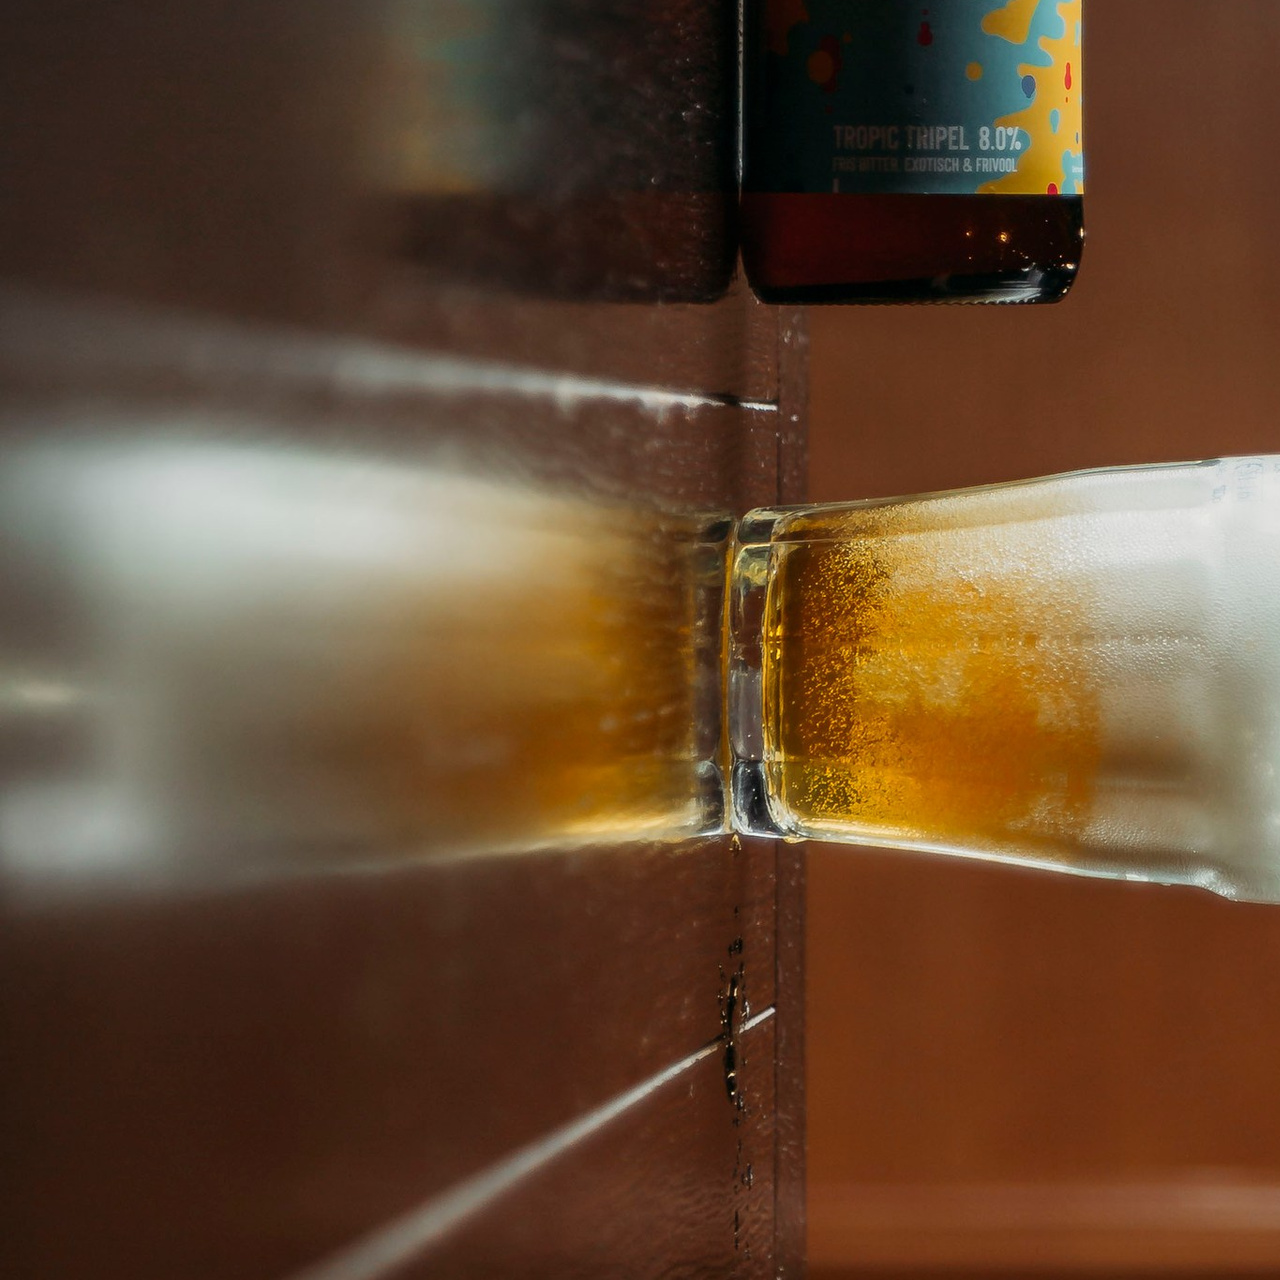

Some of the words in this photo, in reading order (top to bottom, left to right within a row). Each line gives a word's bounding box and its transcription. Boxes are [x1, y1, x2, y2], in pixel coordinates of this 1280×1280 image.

[833, 125, 899, 150] TROPIC
[905, 125, 970, 150] TRIPEL
[978, 125, 1022, 151] 8.0%
[904, 157, 960, 172] EXOTISCH
[962, 157, 973, 173] &
[975, 156, 1018, 173] FRIVOOL
